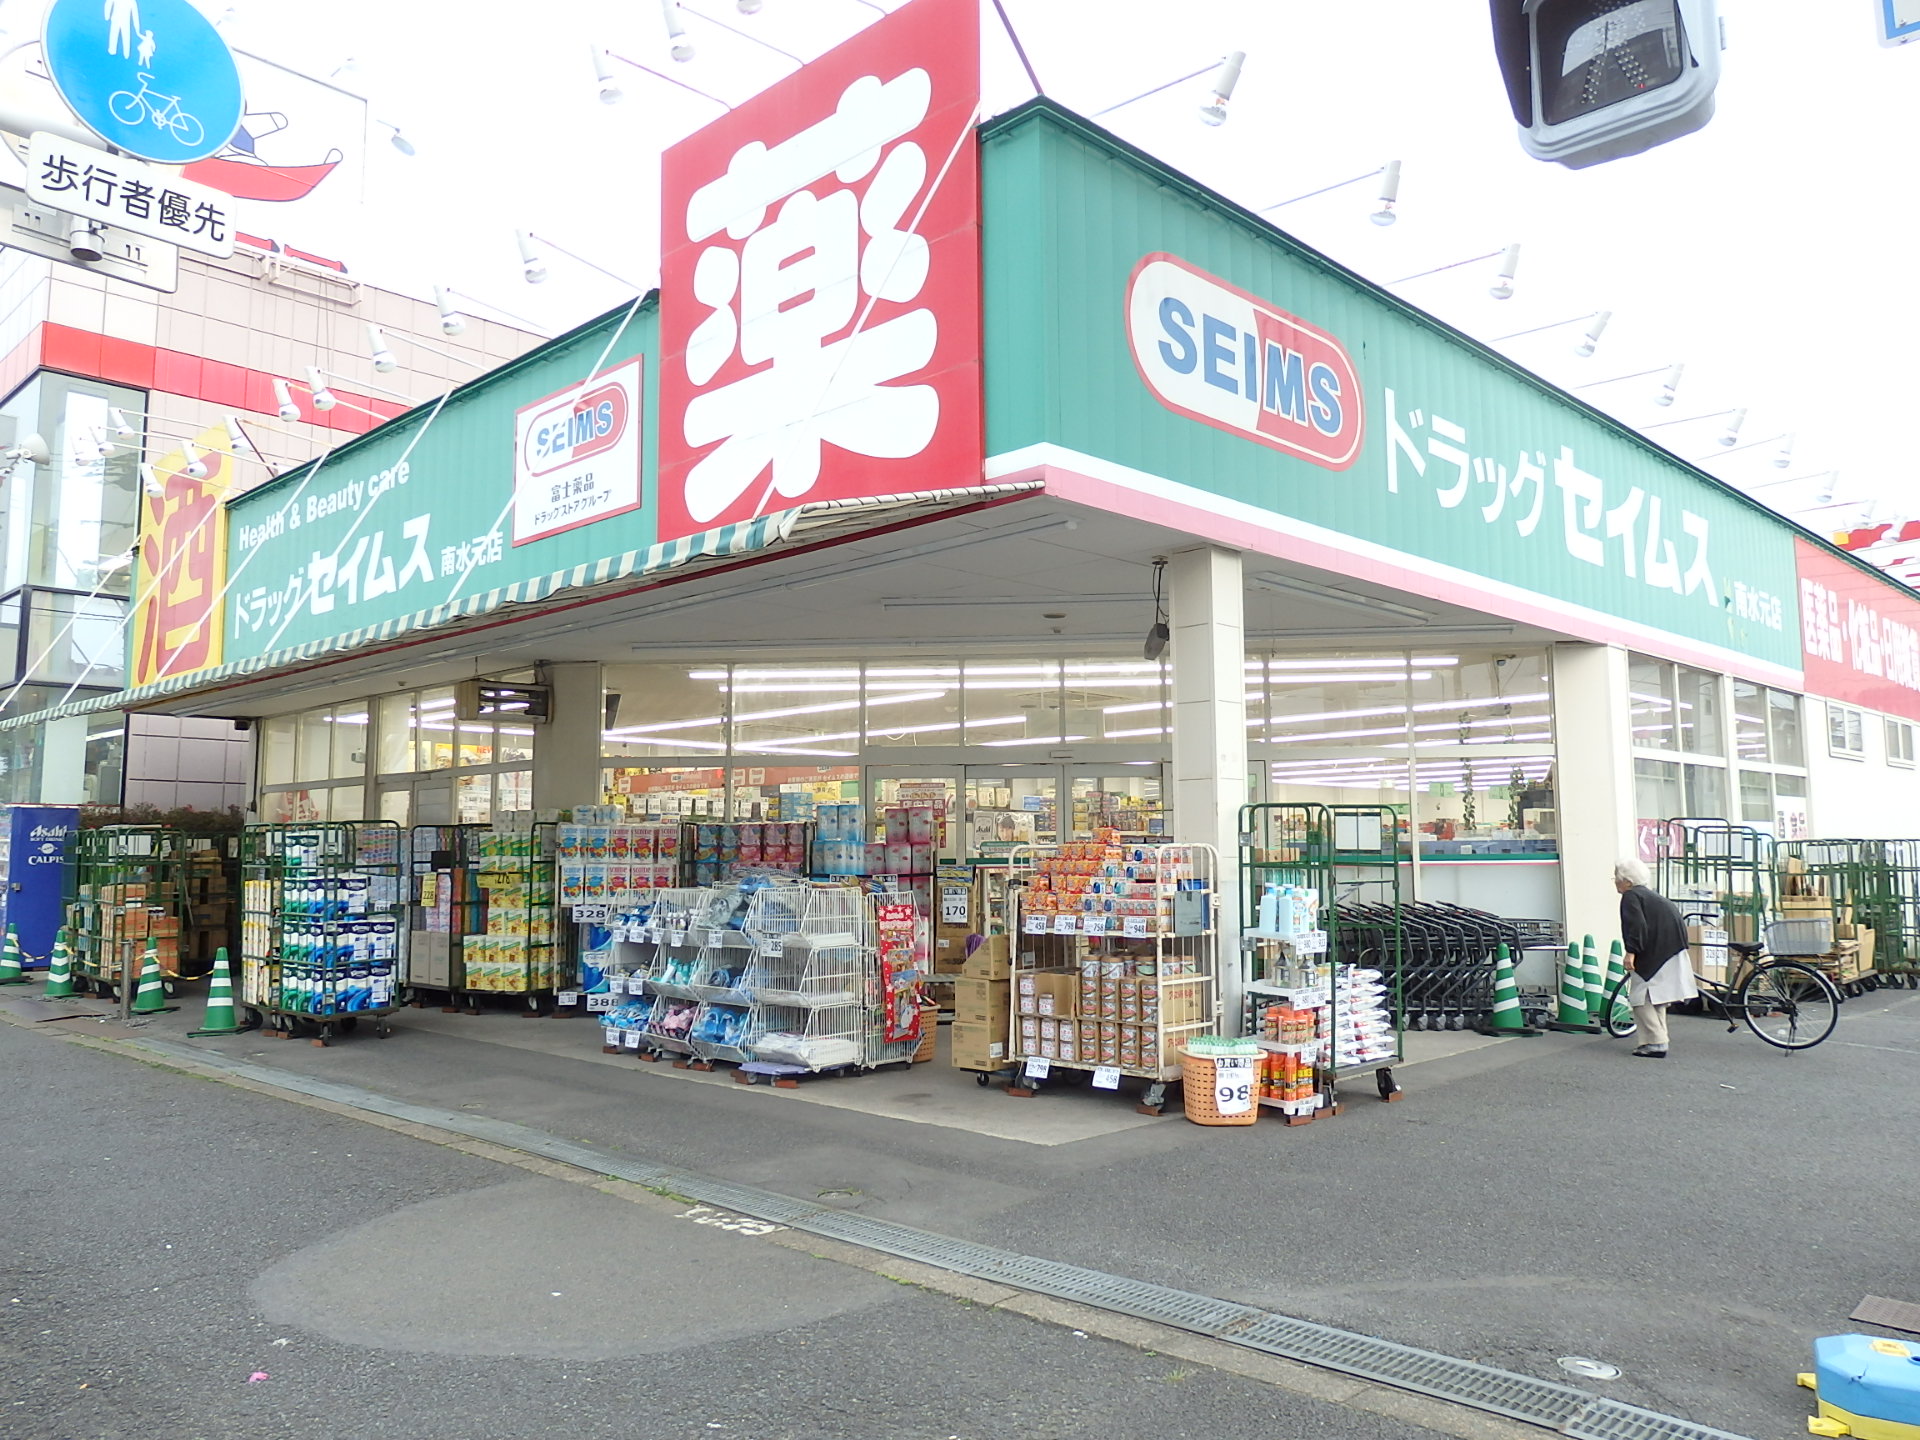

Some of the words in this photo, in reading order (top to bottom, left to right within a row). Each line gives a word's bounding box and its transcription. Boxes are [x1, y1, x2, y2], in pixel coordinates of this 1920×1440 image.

[41, 154, 226, 243] 歩行者優先
[684, 66, 940, 523] 薬
[1158, 296, 1342, 437] SEIMS
[536, 400, 615, 460] SEIMS
[238, 511, 287, 551] Health
[289, 508, 301, 536] &
[305, 479, 367, 524] Beauty
[368, 462, 411, 497] care
[551, 472, 595, 502] 富士薬品
[1384, 386, 1719, 607] ドラッグセイムス
[1734, 580, 1783, 632] 南水元店
[138, 449, 222, 687] 酒
[234, 513, 433, 640] ドラッグセイムス
[440, 531, 503, 578] 南水元店
[30, 824, 68, 837] Asahi
[575, 910, 605, 918] 328
[945, 905, 966, 916] 170
[770, 940, 782, 952] 285
[590, 998, 618, 1007] 388
[1219, 1084, 1249, 1103] 98
